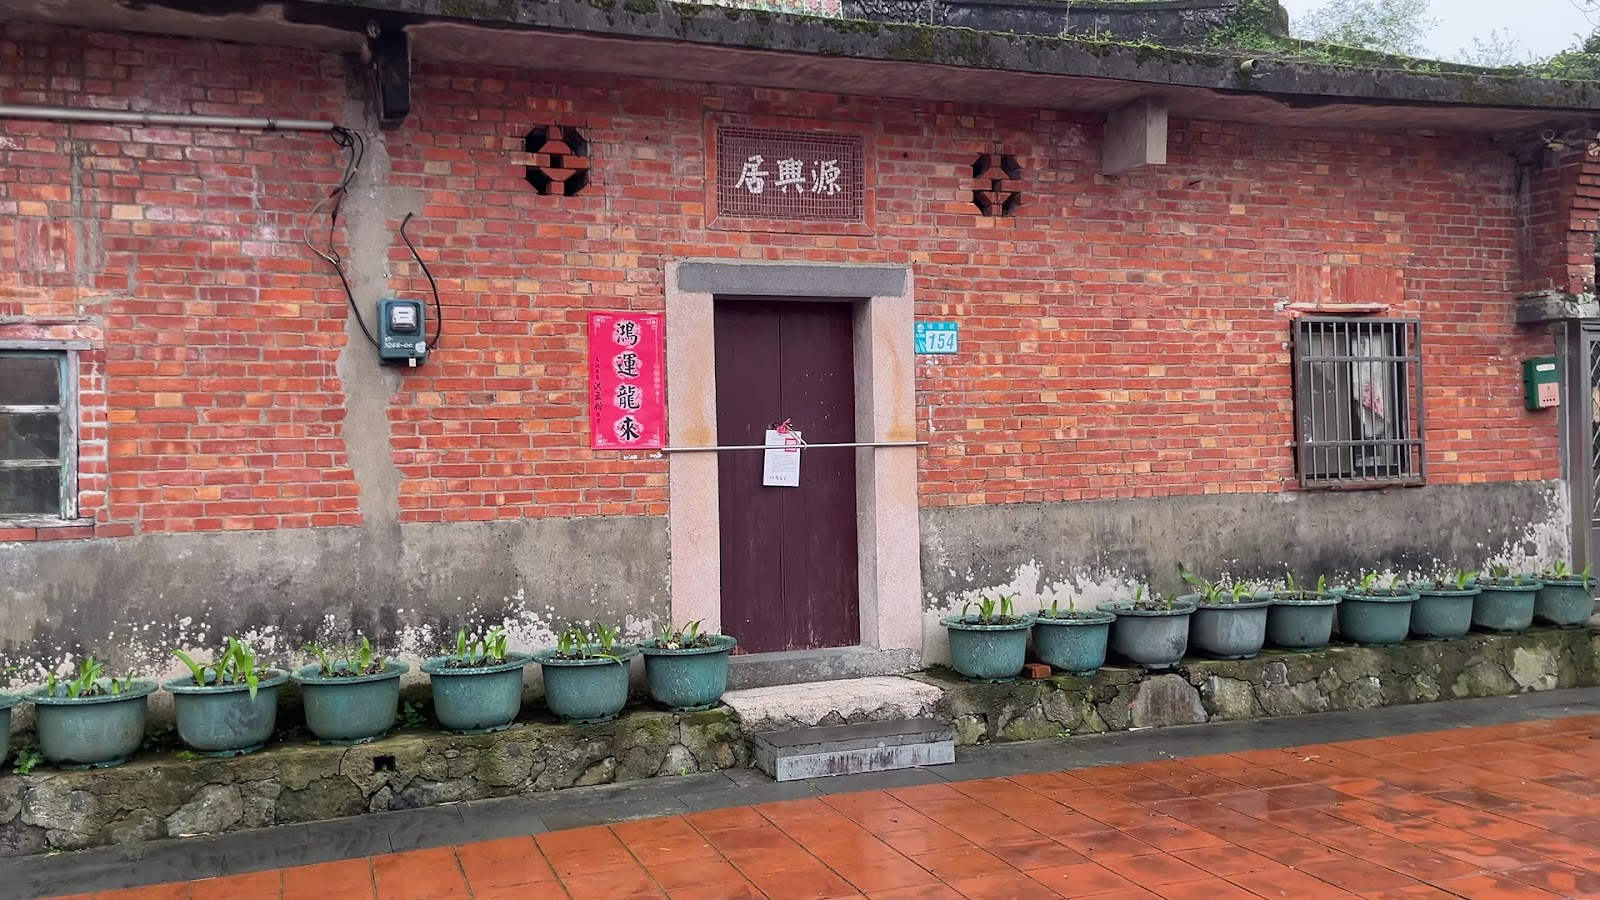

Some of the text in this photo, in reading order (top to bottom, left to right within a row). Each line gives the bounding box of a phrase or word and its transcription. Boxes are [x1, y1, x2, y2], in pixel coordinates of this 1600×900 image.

[929, 333, 955, 350] 154
[616, 321, 640, 441] 鴻運龍來
